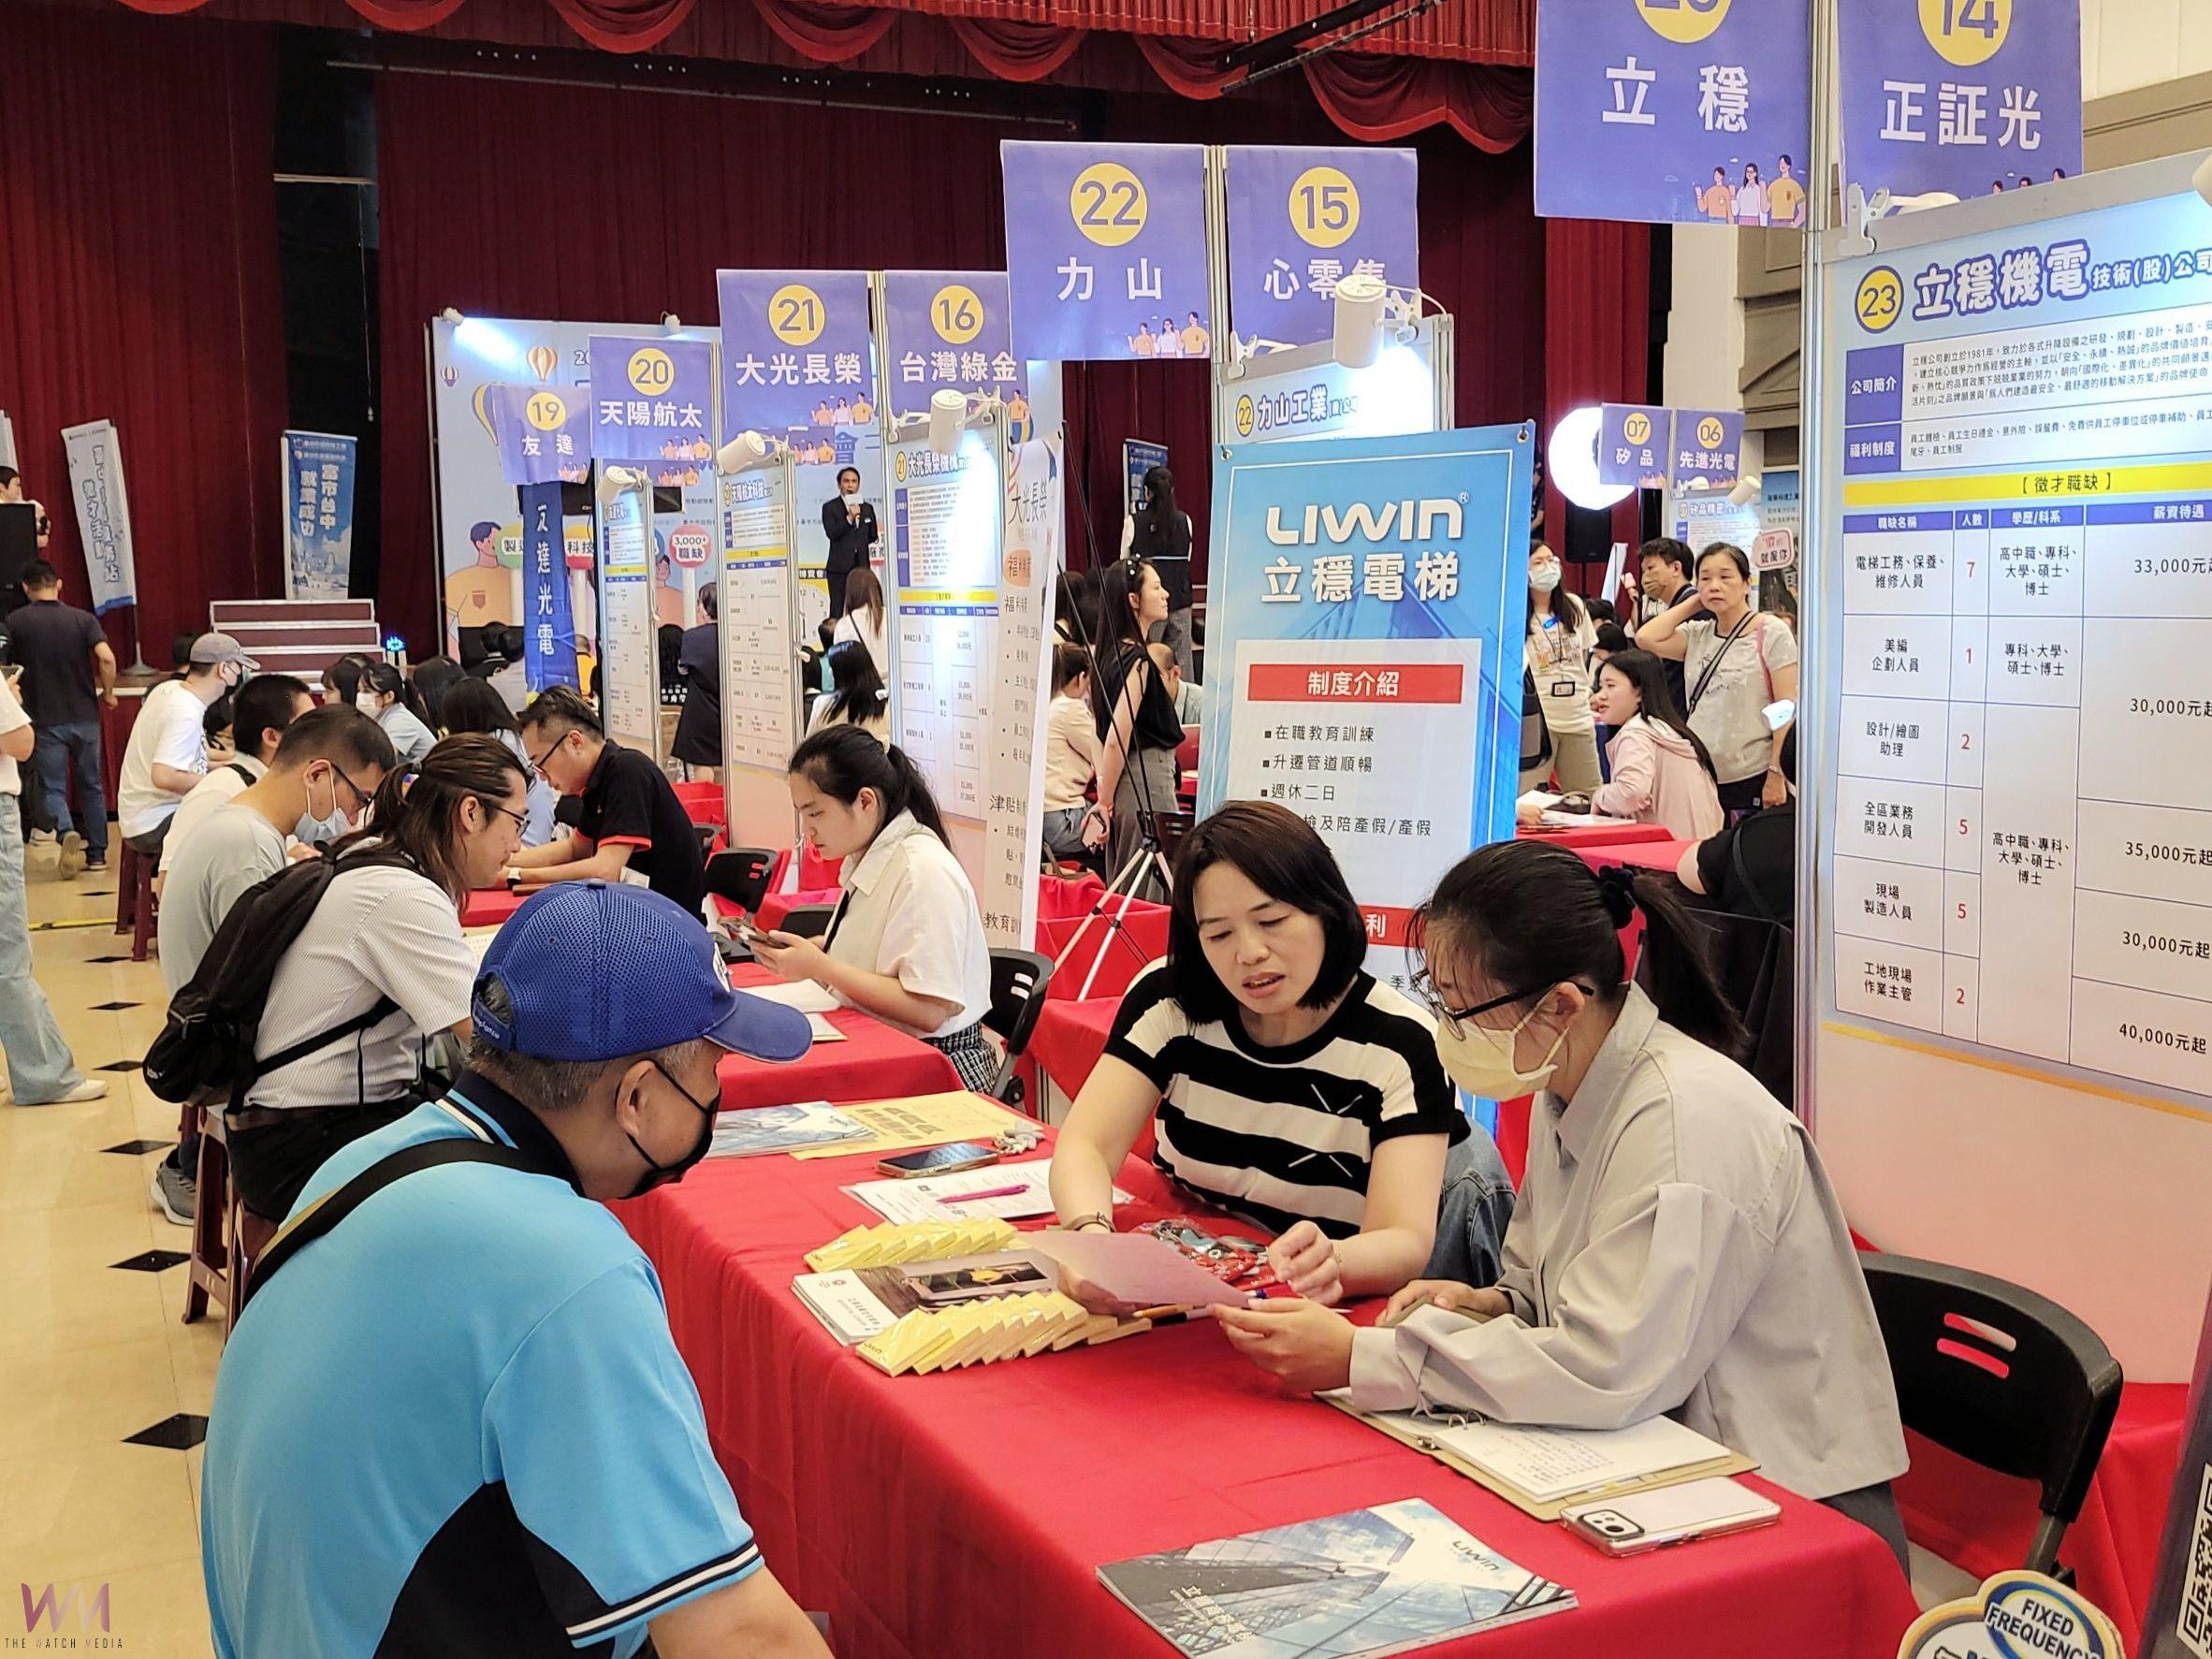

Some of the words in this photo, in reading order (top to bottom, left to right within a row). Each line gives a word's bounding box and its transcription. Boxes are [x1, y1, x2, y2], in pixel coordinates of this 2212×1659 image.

[1941, 0, 2000, 39] 14
[1879, 79, 2042, 151] 正証光
[1080, 180, 1142, 226] 22
[1300, 185, 1349, 230] 15
[1862, 284, 1897, 318] 23
[777, 298, 816, 332] 21
[939, 298, 976, 331] 16
[634, 358, 669, 385] 20
[735, 351, 863, 386] 大光長榮
[899, 351, 1018, 383] 台灣綠金
[1851, 375, 1898, 395] 公司簡介
[531, 400, 560, 423] 19
[599, 400, 703, 429] 天陽航太
[1238, 405, 1252, 427] 22
[1257, 384, 1329, 431] 力山工業
[1625, 419, 1648, 439] 07
[1699, 424, 1721, 443] 06
[1849, 440, 1896, 458] 福利制度
[1679, 450, 1736, 471] 先進光電
[1266, 498, 1463, 545] LIWIN
[1877, 515, 1918, 530] 職缺名稱
[1960, 513, 1983, 527] 人數
[2011, 510, 2062, 525] 學歷/科系
[2153, 504, 2205, 520] 薪資待遇
[1260, 550, 1459, 603] 立穩電梯
[1966, 562, 1975, 578] 7
[2133, 558, 2212, 576] 33,000元
[1874, 574, 1924, 589] 維修人員
[2025, 580, 2050, 596] 博士
[1884, 638, 1908, 653] 美編
[1871, 657, 1919, 674] 企劃人員
[1966, 648, 1972, 664] 1
[2007, 661, 2065, 677] 碩士、博士
[1307, 670, 1400, 697] 制度介紹
[1275, 724, 1375, 742] 在職教育訓練
[1866, 721, 1920, 739] 設計/繪圖
[1879, 742, 1904, 757] 助理
[1960, 735, 1971, 750] 2
[1273, 753, 1373, 773] 升遷管道順暢
[1271, 783, 1335, 801] 週休二日
[1864, 801, 1914, 821] 全區業務
[1863, 820, 1914, 839] 開發人員
[1958, 820, 1969, 835] 5
[2125, 841, 2212, 865] 35,000元起
[2017, 869, 2043, 885] 博士
[1875, 883, 1899, 899] 現場
[1863, 899, 1913, 921] 製造人員
[1957, 903, 1967, 919] 5
[2122, 931, 2210, 959] 30,000元起
[1863, 963, 1912, 983] 工地現場
[1863, 981, 1912, 1002] 作業主管
[1956, 988, 1966, 1005] 2
[2118, 1023, 2207, 1055] 40,000元起
[2021, 1598, 2074, 1637] FIXED
